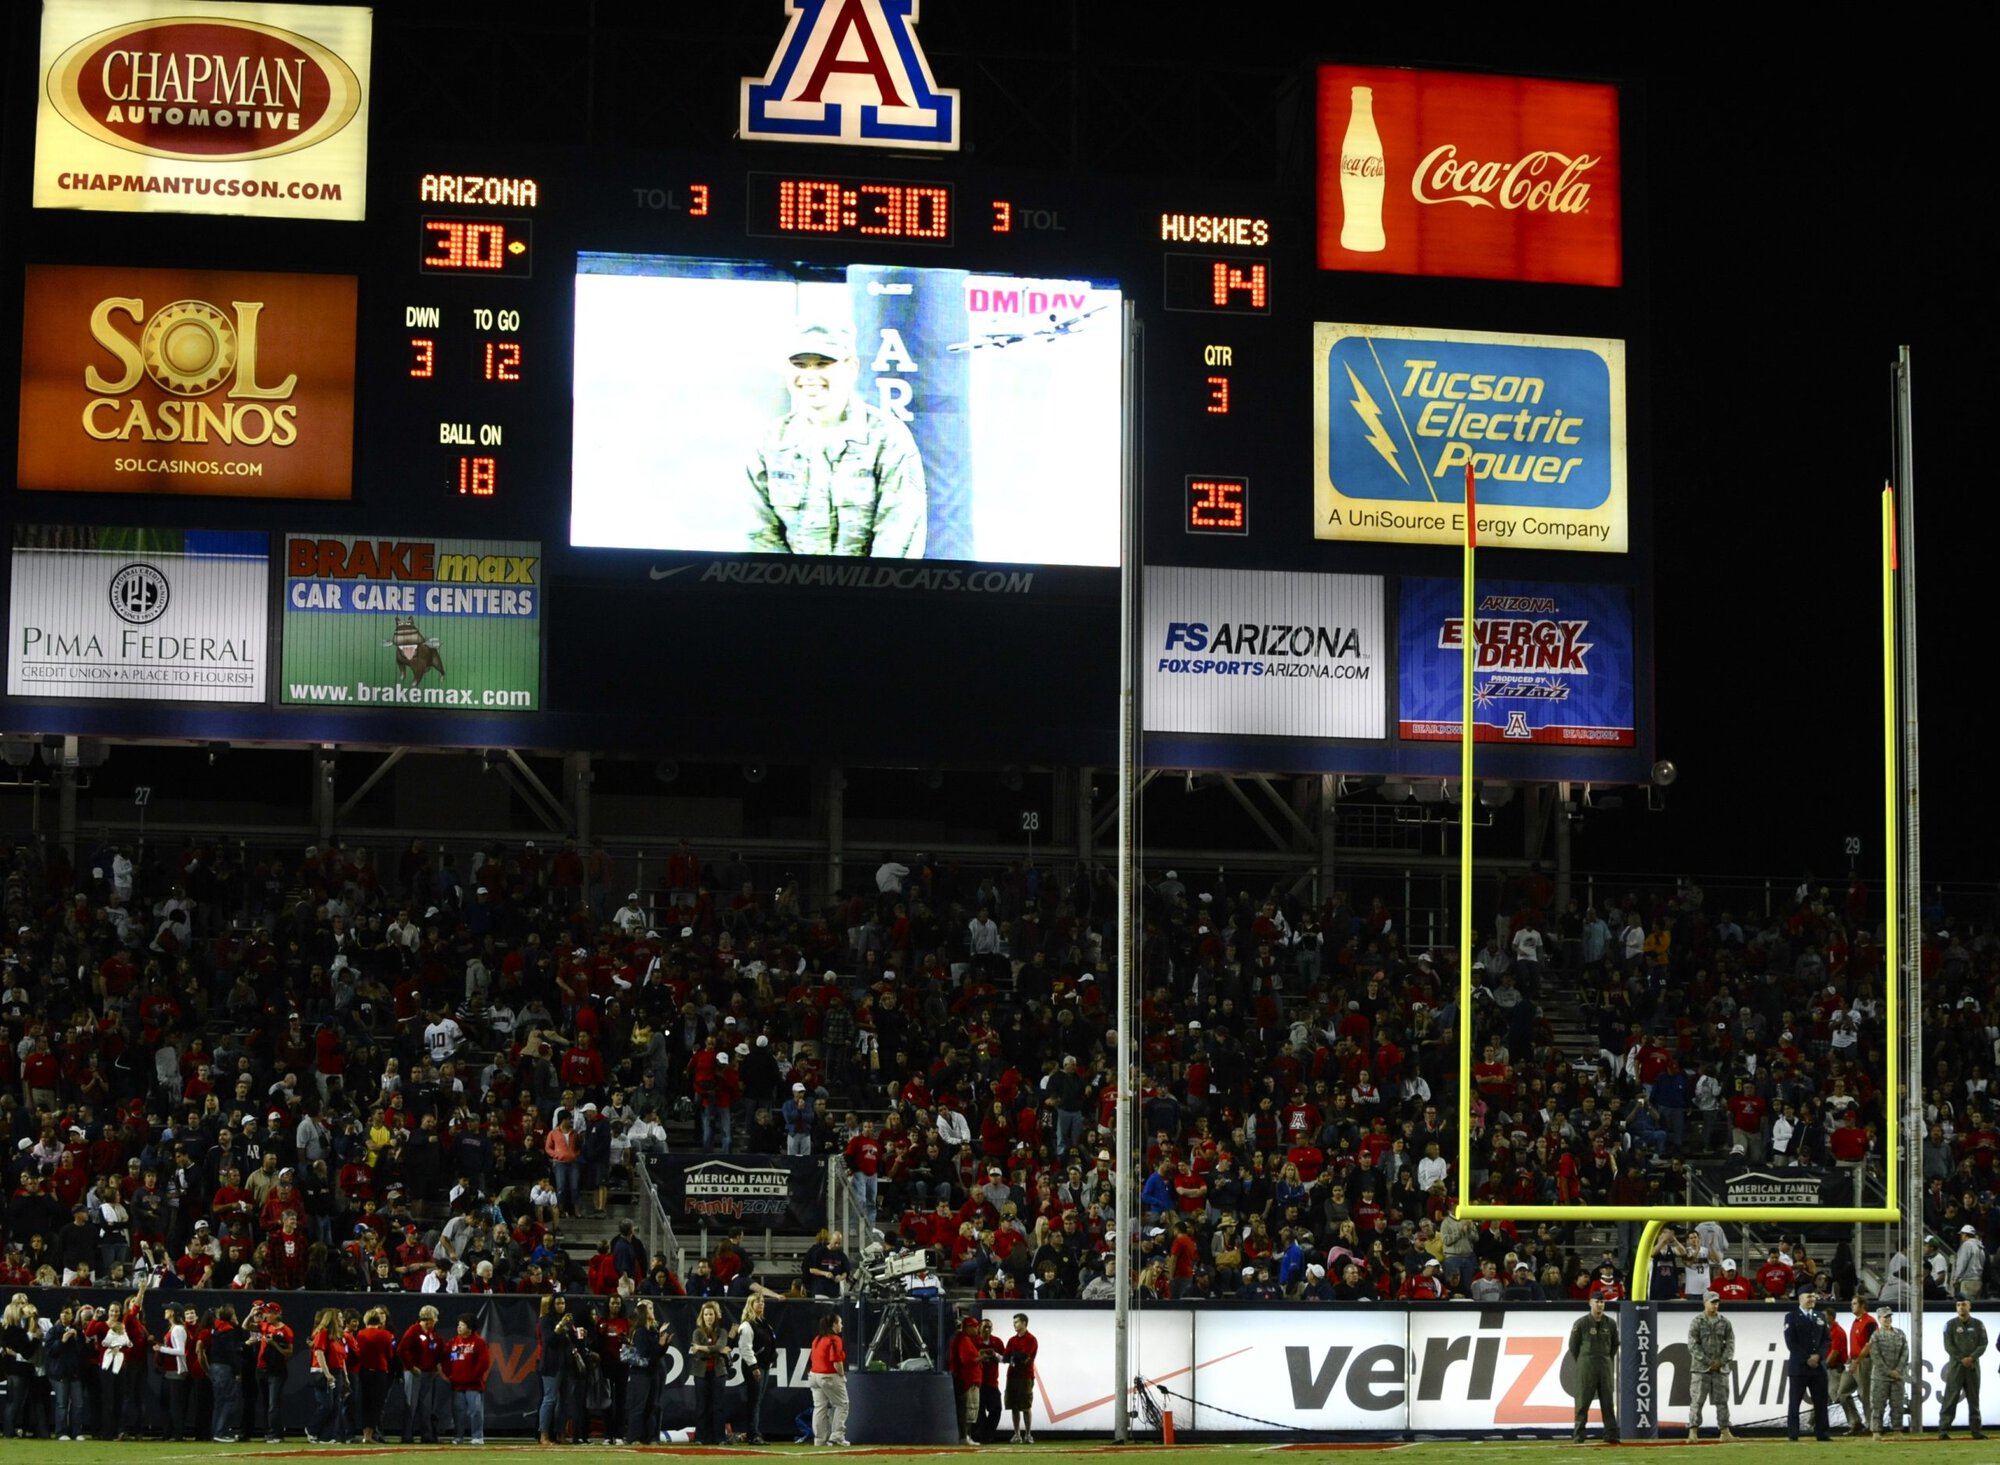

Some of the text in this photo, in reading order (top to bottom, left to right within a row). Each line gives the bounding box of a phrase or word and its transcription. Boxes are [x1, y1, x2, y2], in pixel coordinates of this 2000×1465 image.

[102, 50, 306, 109] CHAPMAN
[106, 105, 300, 130] AUTOMOTIVE
[57, 172, 342, 201] CHAPMANTUCSON.COM
[420, 174, 537, 206] ARIZONA
[1411, 144, 1601, 214] Coca-Cola
[633, 188, 680, 210] TOL
[689, 185, 708, 215] 3
[780, 181, 946, 237] 18:30
[992, 201, 1011, 232] 3
[1019, 209, 1065, 231] TOL
[1162, 214, 1269, 246] HUSKIES
[425, 221, 504, 269] 30
[1213, 263, 1265, 307] 14
[970, 289, 1019, 314] DM
[406, 306, 440, 329] DWN
[474, 309, 520, 332] TO GO
[84, 296, 298, 401] SOL
[410, 340, 433, 377] 3
[484, 342, 520, 380] 12
[1204, 345, 1232, 367] QTR
[1207, 376, 1229, 413] 3
[1402, 359, 1545, 405] Tucson
[81, 400, 298, 447] CASINOS
[439, 423, 502, 446] BALL ON
[1416, 402, 1583, 444] Electric
[114, 458, 263, 477] SOLCASINOS.COM
[459, 457, 495, 496] 18
[1433, 441, 1583, 485] Power
[1191, 482, 1243, 527] 25
[1329, 510, 1610, 540] A UniSource Eergy Company
[700, 561, 1034, 594] ARIZONAWILDCATS.COM
[291, 583, 533, 615] CAR CARE CENTERS
[1479, 596, 1555, 613] ARIZONA
[1158, 658, 1370, 680] FOXSPORTSARIZONA.COM
[1474, 643, 1593, 675] DRINK
[22, 666, 254, 683] CREDIT UNION A PLACE TO FLOURISH
[290, 683, 531, 706] www.brakemax.com
[1504, 711, 1531, 738] A
[134, 787, 151, 805] 27
[1022, 811, 1040, 831] 28
[1844, 837, 1861, 855] 29
[432, 1032, 445, 1049] 10
[1289, 1111, 1308, 1130] A
[686, 1174, 788, 1185] AMERICAN FAMILY
[693, 1186, 781, 1194] INSURANCE
[1727, 1184, 1820, 1195] AMERICAN FAMILY
[1285, 1311, 1693, 1425] verizn
[1636, 1320, 1651, 1428] ARIZONA
